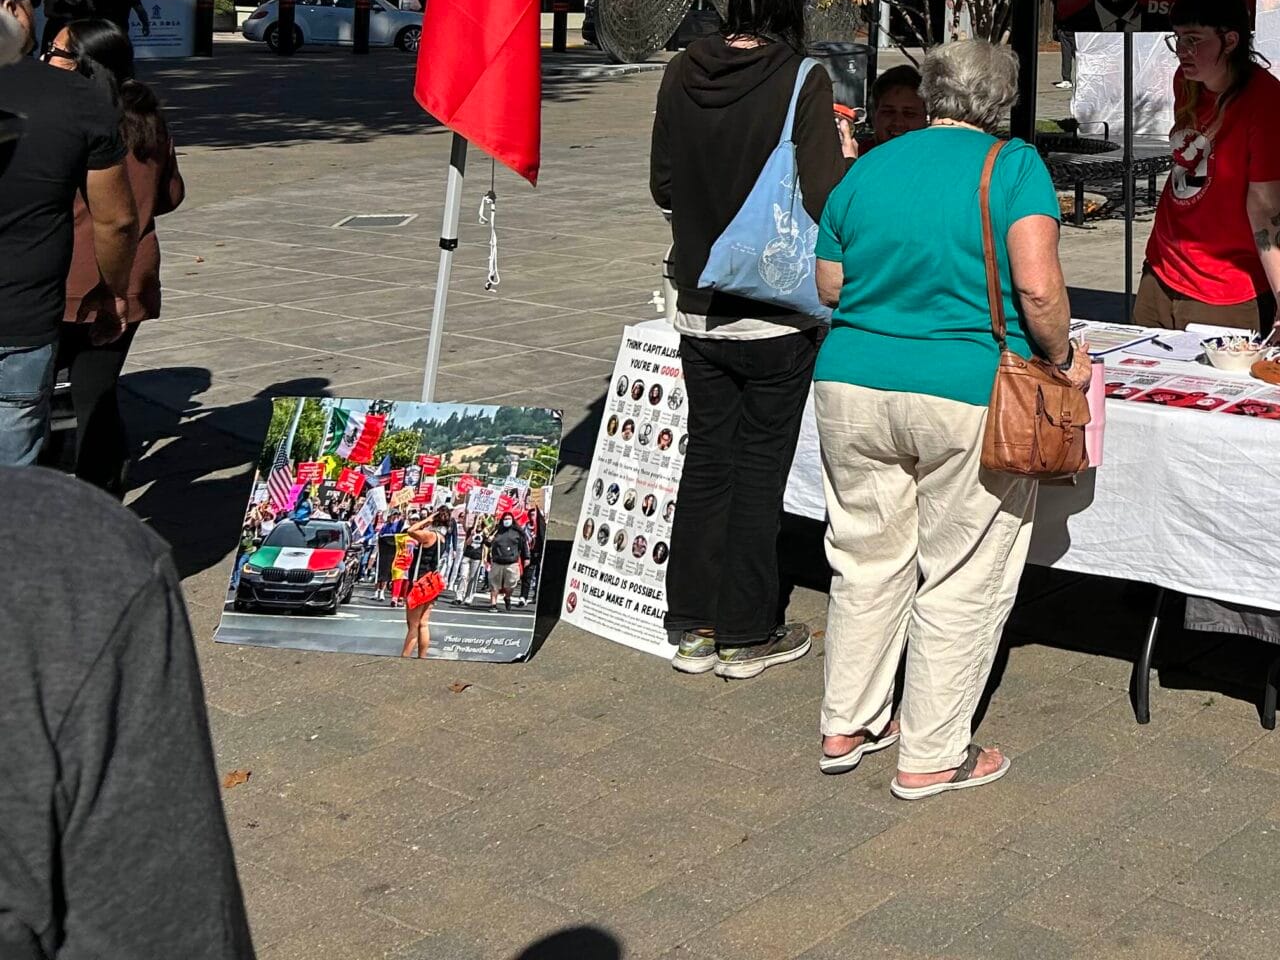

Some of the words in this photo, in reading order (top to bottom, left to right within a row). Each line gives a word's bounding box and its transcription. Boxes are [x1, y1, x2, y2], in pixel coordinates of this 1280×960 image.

[626, 339, 642, 350] THINK
[630, 358, 650, 371] YOU'RE
[652, 363, 660, 373] IN
[660, 365, 680, 378] GOOD
[479, 487, 494, 495] STOP
[572, 561, 577, 570] A
[578, 564, 599, 578] BETTER
[599, 572, 620, 587] WORLD
[620, 579, 628, 590] IS
[629, 582, 664, 601] POSSIBLE:
[570, 578, 580, 590] DSA
[581, 583, 589, 594] TO
[589, 586, 605, 599] HELP
[606, 592, 623, 607] MAKE
[625, 599, 633, 609] IT
[634, 603, 640, 612] A
[444, 634, 461, 643] Photo
[485, 637, 494, 646] of
